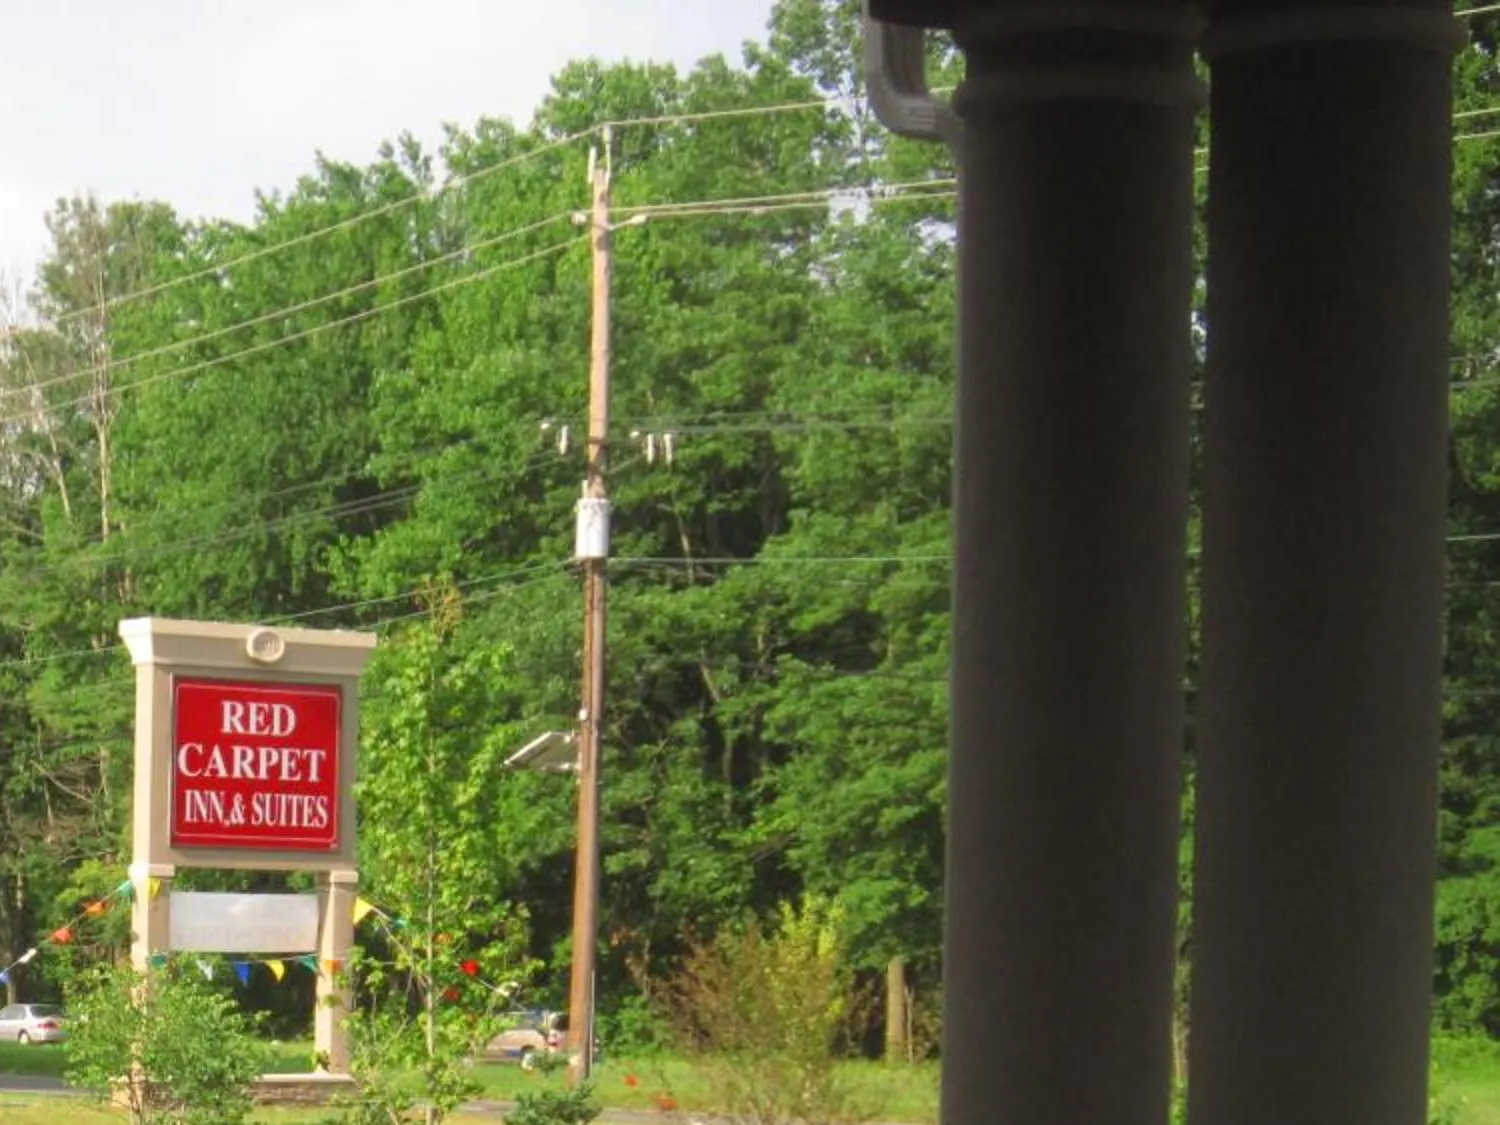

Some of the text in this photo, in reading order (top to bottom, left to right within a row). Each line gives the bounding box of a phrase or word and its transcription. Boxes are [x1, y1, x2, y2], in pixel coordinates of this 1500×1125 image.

[220, 700, 297, 737] RED
[177, 743, 326, 783] CARPET
[251, 792, 329, 829] SUITES
